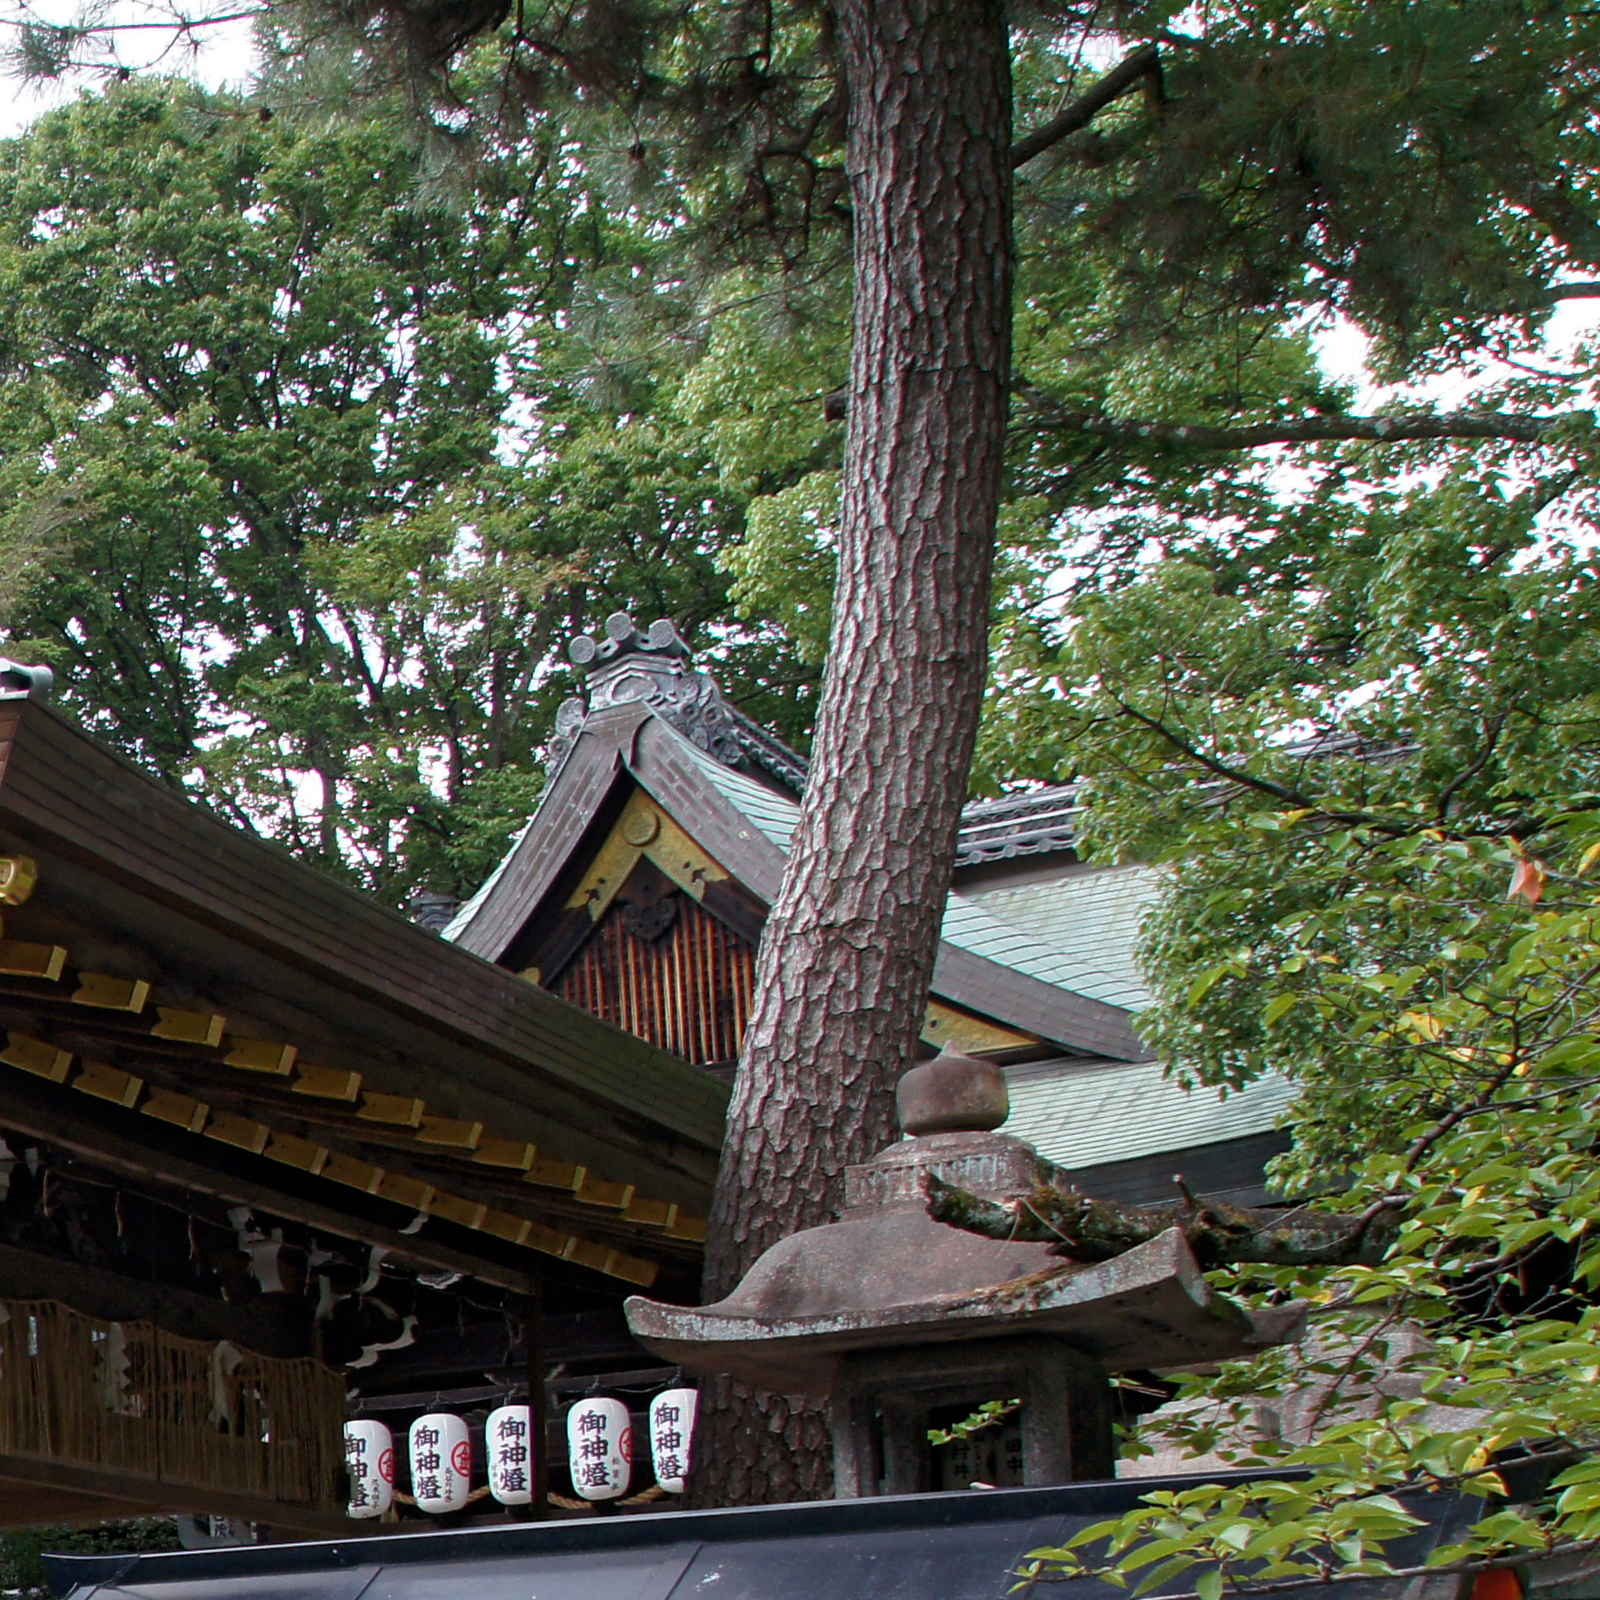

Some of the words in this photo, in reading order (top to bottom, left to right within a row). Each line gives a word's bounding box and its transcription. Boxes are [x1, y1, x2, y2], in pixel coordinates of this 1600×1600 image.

[414, 1424, 443, 1500] 御神燈
[497, 1415, 527, 1493] 御神燈
[577, 1409, 611, 1488] 御神燈
[651, 1402, 683, 1479] 御神燈
